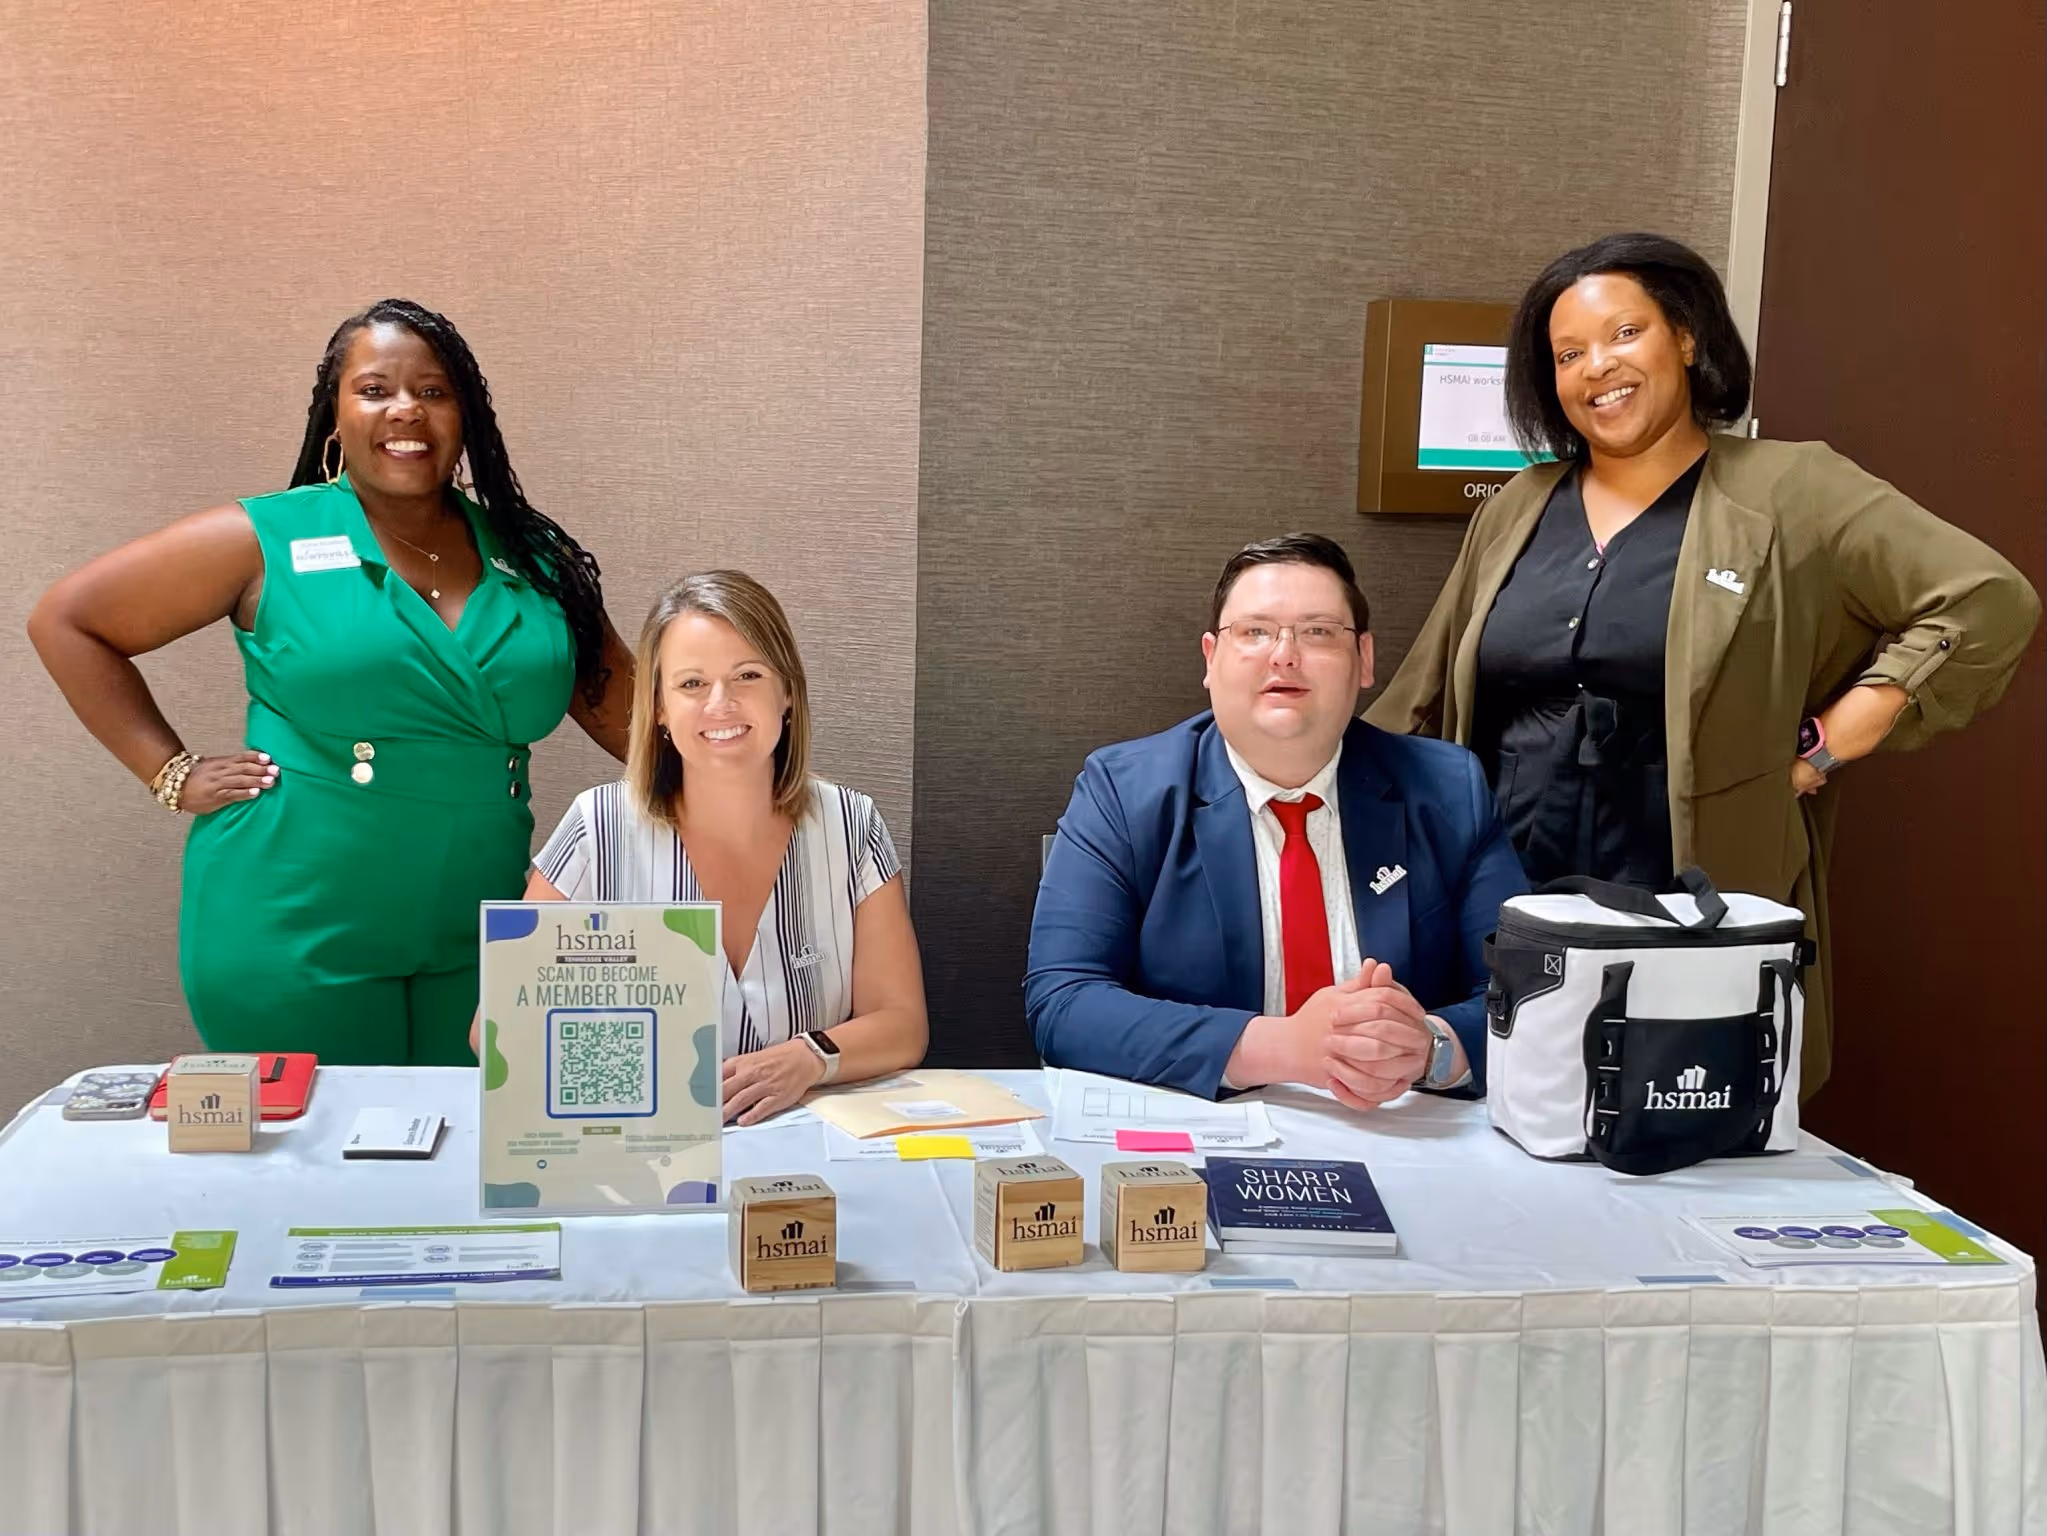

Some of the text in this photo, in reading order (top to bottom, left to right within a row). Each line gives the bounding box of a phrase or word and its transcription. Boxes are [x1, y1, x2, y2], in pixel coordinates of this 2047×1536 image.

[1440, 375, 1470, 385] HSMAI
[556, 924, 637, 950] hsmai
[537, 965, 659, 983] SCAN TO BECOME
[516, 983, 688, 1007] A MEMBER TODAY
[1643, 1080, 1731, 1110] hsmai
[177, 1103, 244, 1125] hsmai
[749, 1182, 823, 1195] hsmai
[1243, 1168, 1341, 1187] SHARP
[1236, 1183, 1353, 1204] WOMEN
[1012, 1215, 1078, 1240] hsmai
[1130, 1219, 1198, 1243] hsmai
[756, 1234, 829, 1259] hsmai
